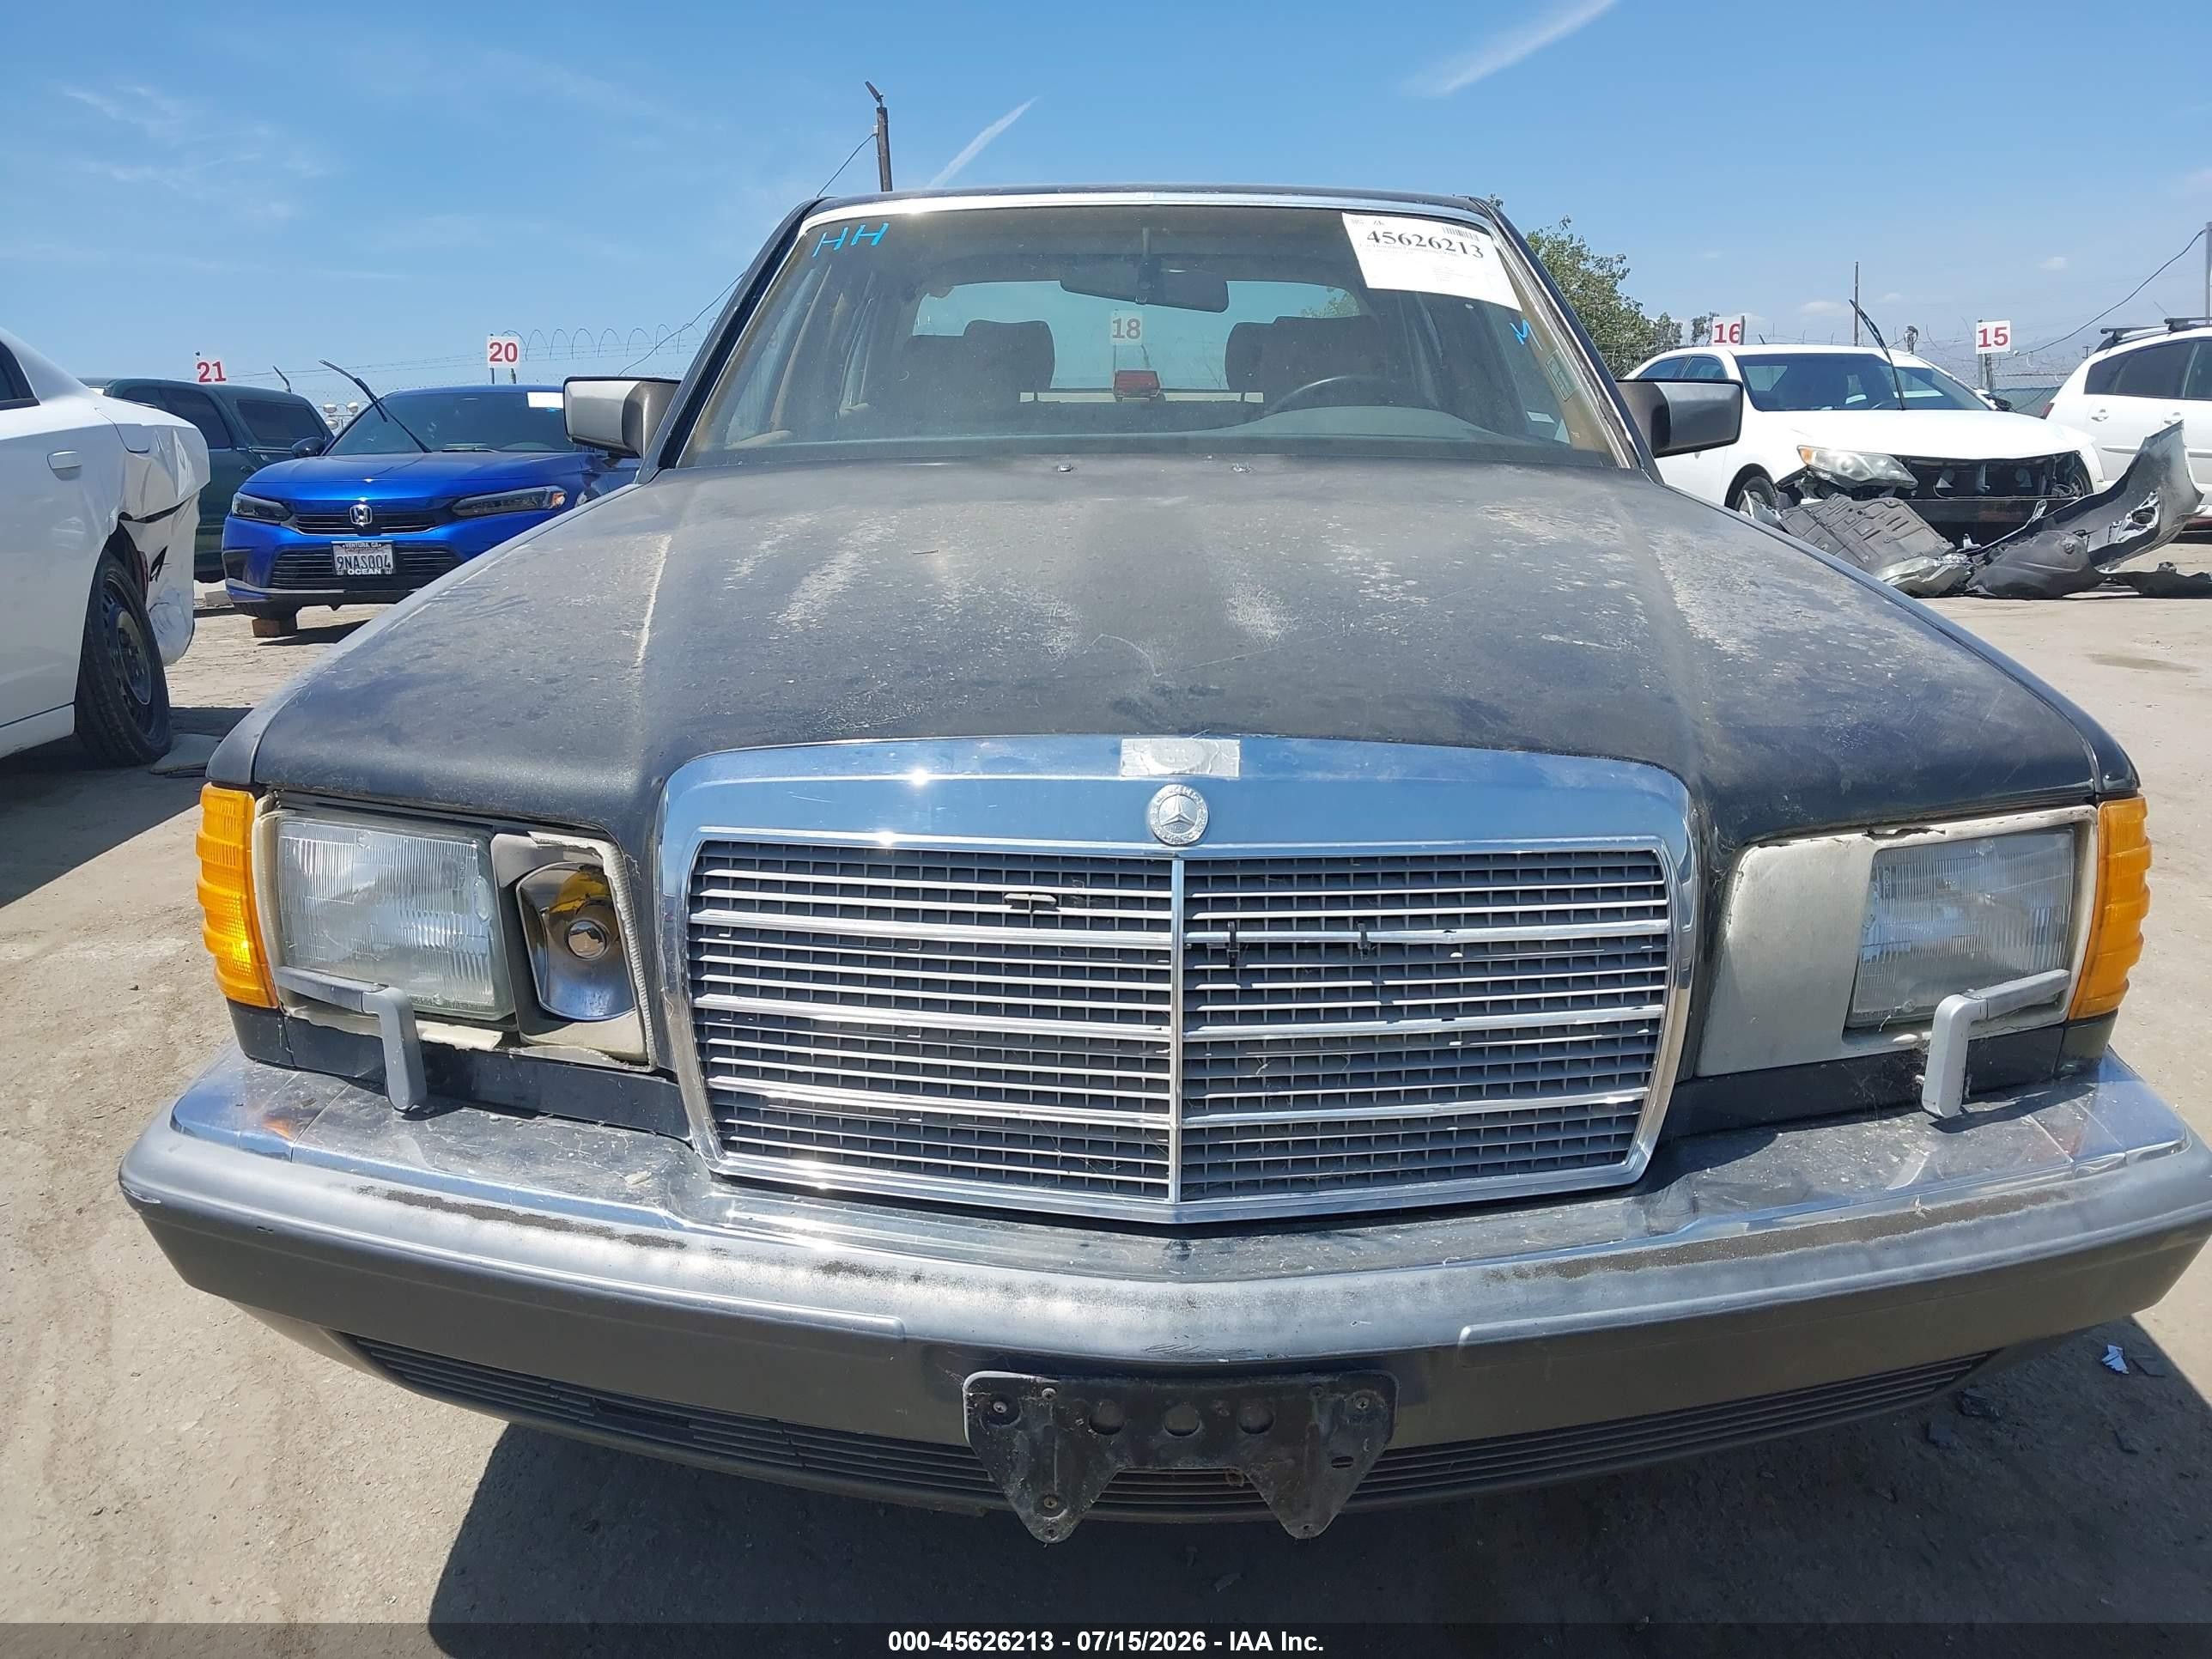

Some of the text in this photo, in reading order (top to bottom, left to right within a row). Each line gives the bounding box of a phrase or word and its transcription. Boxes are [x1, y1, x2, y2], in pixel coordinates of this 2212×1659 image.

[1367, 229, 1485, 259] 45626213
[1112, 317, 1141, 340] 18
[1713, 323, 1741, 343] 16
[1978, 326, 2009, 349] 15
[489, 342, 518, 363] 20
[196, 361, 228, 383] 21
